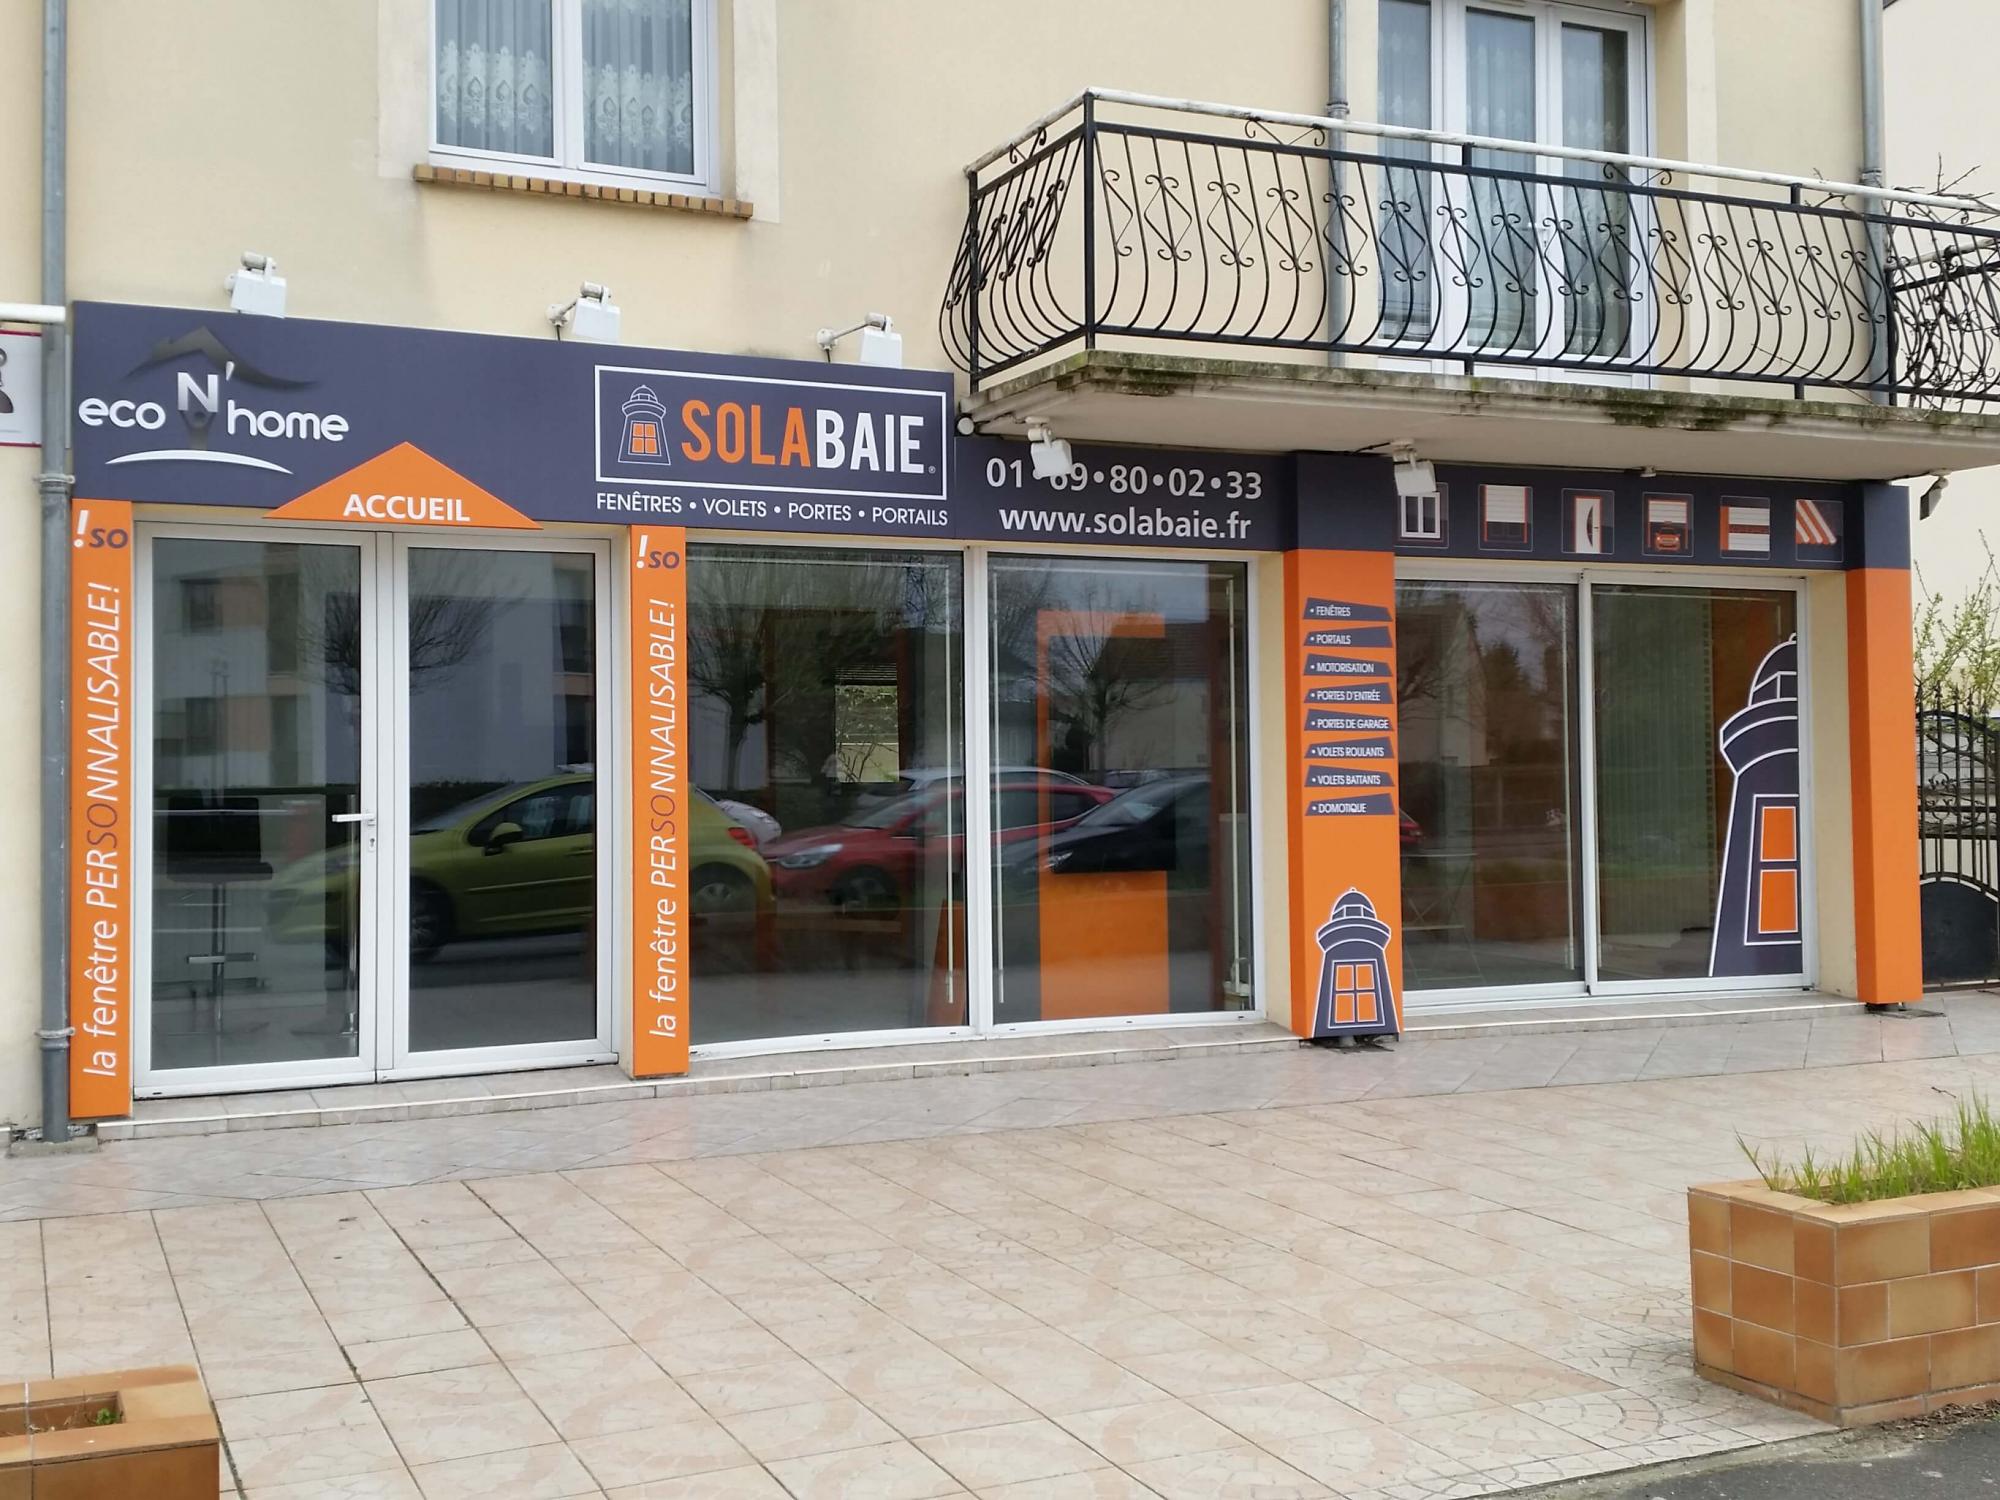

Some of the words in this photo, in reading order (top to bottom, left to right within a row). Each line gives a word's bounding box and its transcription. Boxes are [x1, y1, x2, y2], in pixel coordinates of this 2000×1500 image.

[79, 398, 166, 430] eco
[227, 400, 349, 442] home
[681, 400, 924, 474] SOLABAIE
[343, 493, 470, 522] ACCUEIL
[597, 491, 682, 513] FENÊTRES
[703, 498, 767, 517] VOLETS
[788, 503, 851, 521] PORTES
[872, 507, 948, 526] PORTAILS
[999, 506, 1252, 539] www.solabaie.fr
[1316, 604, 1351, 617] FENÊTRES
[1316, 634, 1351, 645] PORTAILS
[1316, 662, 1374, 673] MOTORISATION
[1316, 690, 1345, 701] PORTES
[1346, 688, 1381, 701] D'ENTRÉE
[1317, 719, 1345, 729] PORTES
[1345, 719, 1356, 729] DE
[1357, 719, 1389, 729] GARAGE
[1317, 747, 1345, 757] VOLETS
[1346, 747, 1385, 757] ROULANTS
[1317, 775, 1345, 785] VOLETS
[1346, 775, 1381, 785] BATTANTS
[1318, 803, 1367, 813] DOMOTIQUE
[649, 898, 676, 1002] fenêtre
[83, 920, 117, 1037] fenêtre
[649, 1013, 676, 1038] la
[83, 1051, 116, 1077] la
